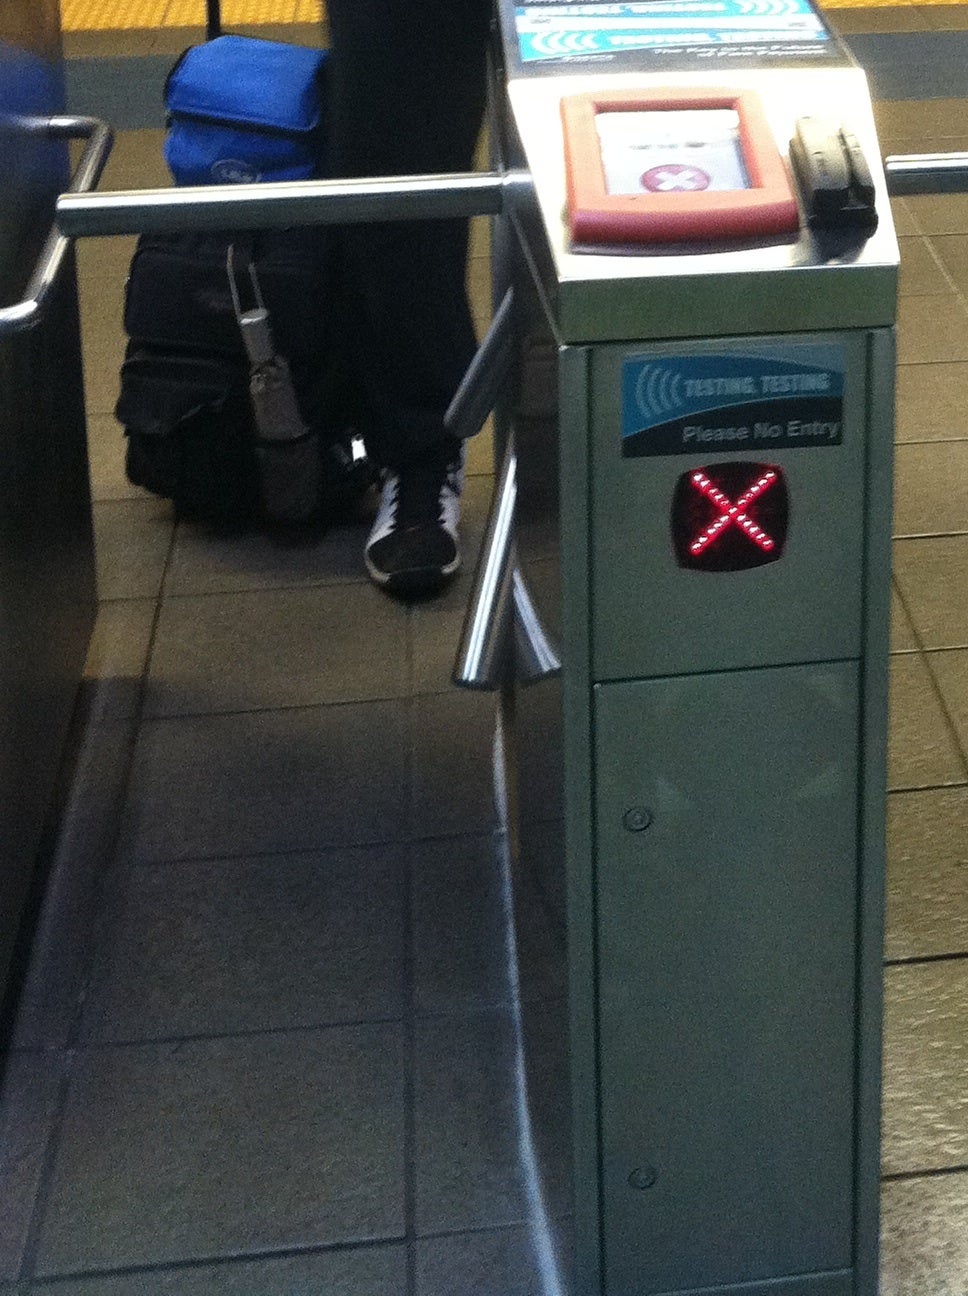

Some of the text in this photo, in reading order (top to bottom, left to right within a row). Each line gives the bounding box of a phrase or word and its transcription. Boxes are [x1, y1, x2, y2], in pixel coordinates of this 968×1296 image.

[682, 419, 841, 443] Please No Entry
